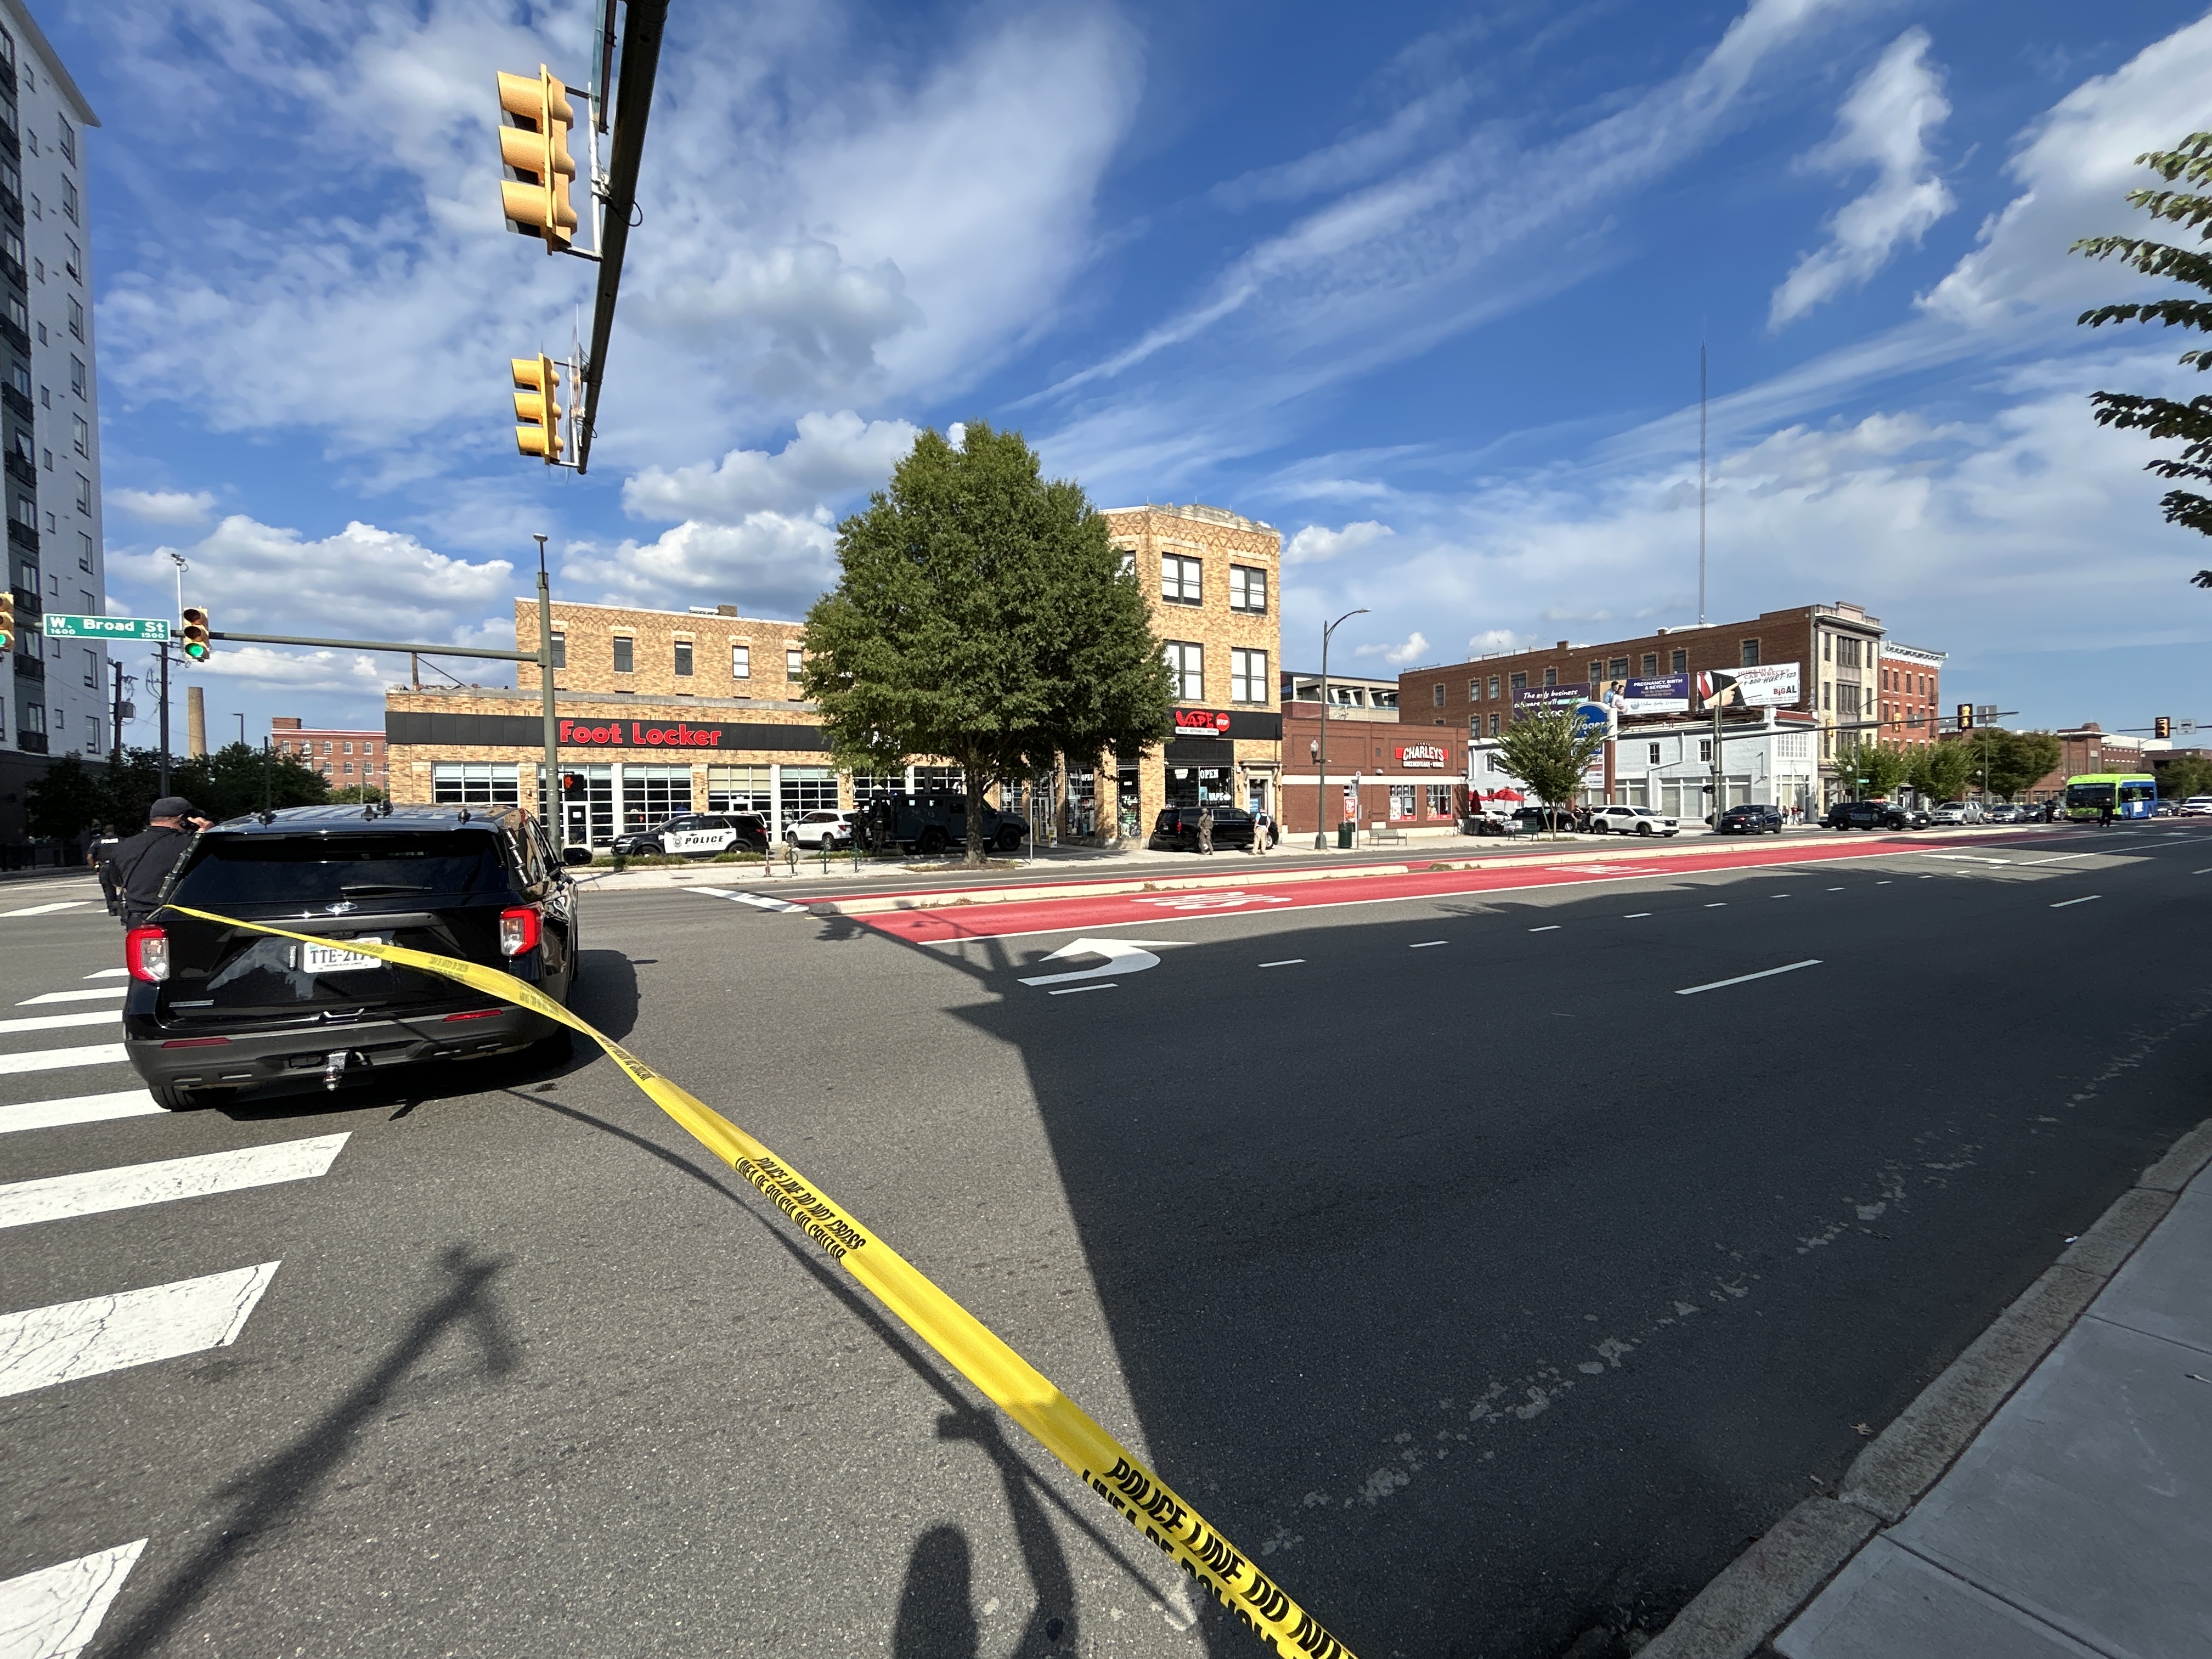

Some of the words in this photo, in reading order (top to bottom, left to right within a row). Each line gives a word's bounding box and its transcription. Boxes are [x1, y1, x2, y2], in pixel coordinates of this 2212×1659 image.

[50, 617, 72, 629] W.
[83, 618, 134, 631] Broad
[145, 621, 165, 633] St
[560, 720, 623, 744] Foot
[632, 722, 722, 746] Locker
[1403, 746, 1444, 761] CHARLEYS
[1081, 773, 1094, 781] OPEN
[1200, 769, 1219, 780] OPEN
[685, 835, 724, 844] POLICE
[1130, 891, 1293, 910] BUS
[752, 1157, 788, 1179] POLICE
[775, 1177, 805, 1194] LINE
[792, 1192, 816, 1205] DO
[804, 1203, 836, 1221] NOT
[823, 1219, 866, 1250] CROSS
[1102, 1456, 1188, 1534] POLICE
[1179, 1521, 1246, 1584] LINE
[1239, 1571, 1290, 1623] DO
[1285, 1611, 1358, 1659] NO
